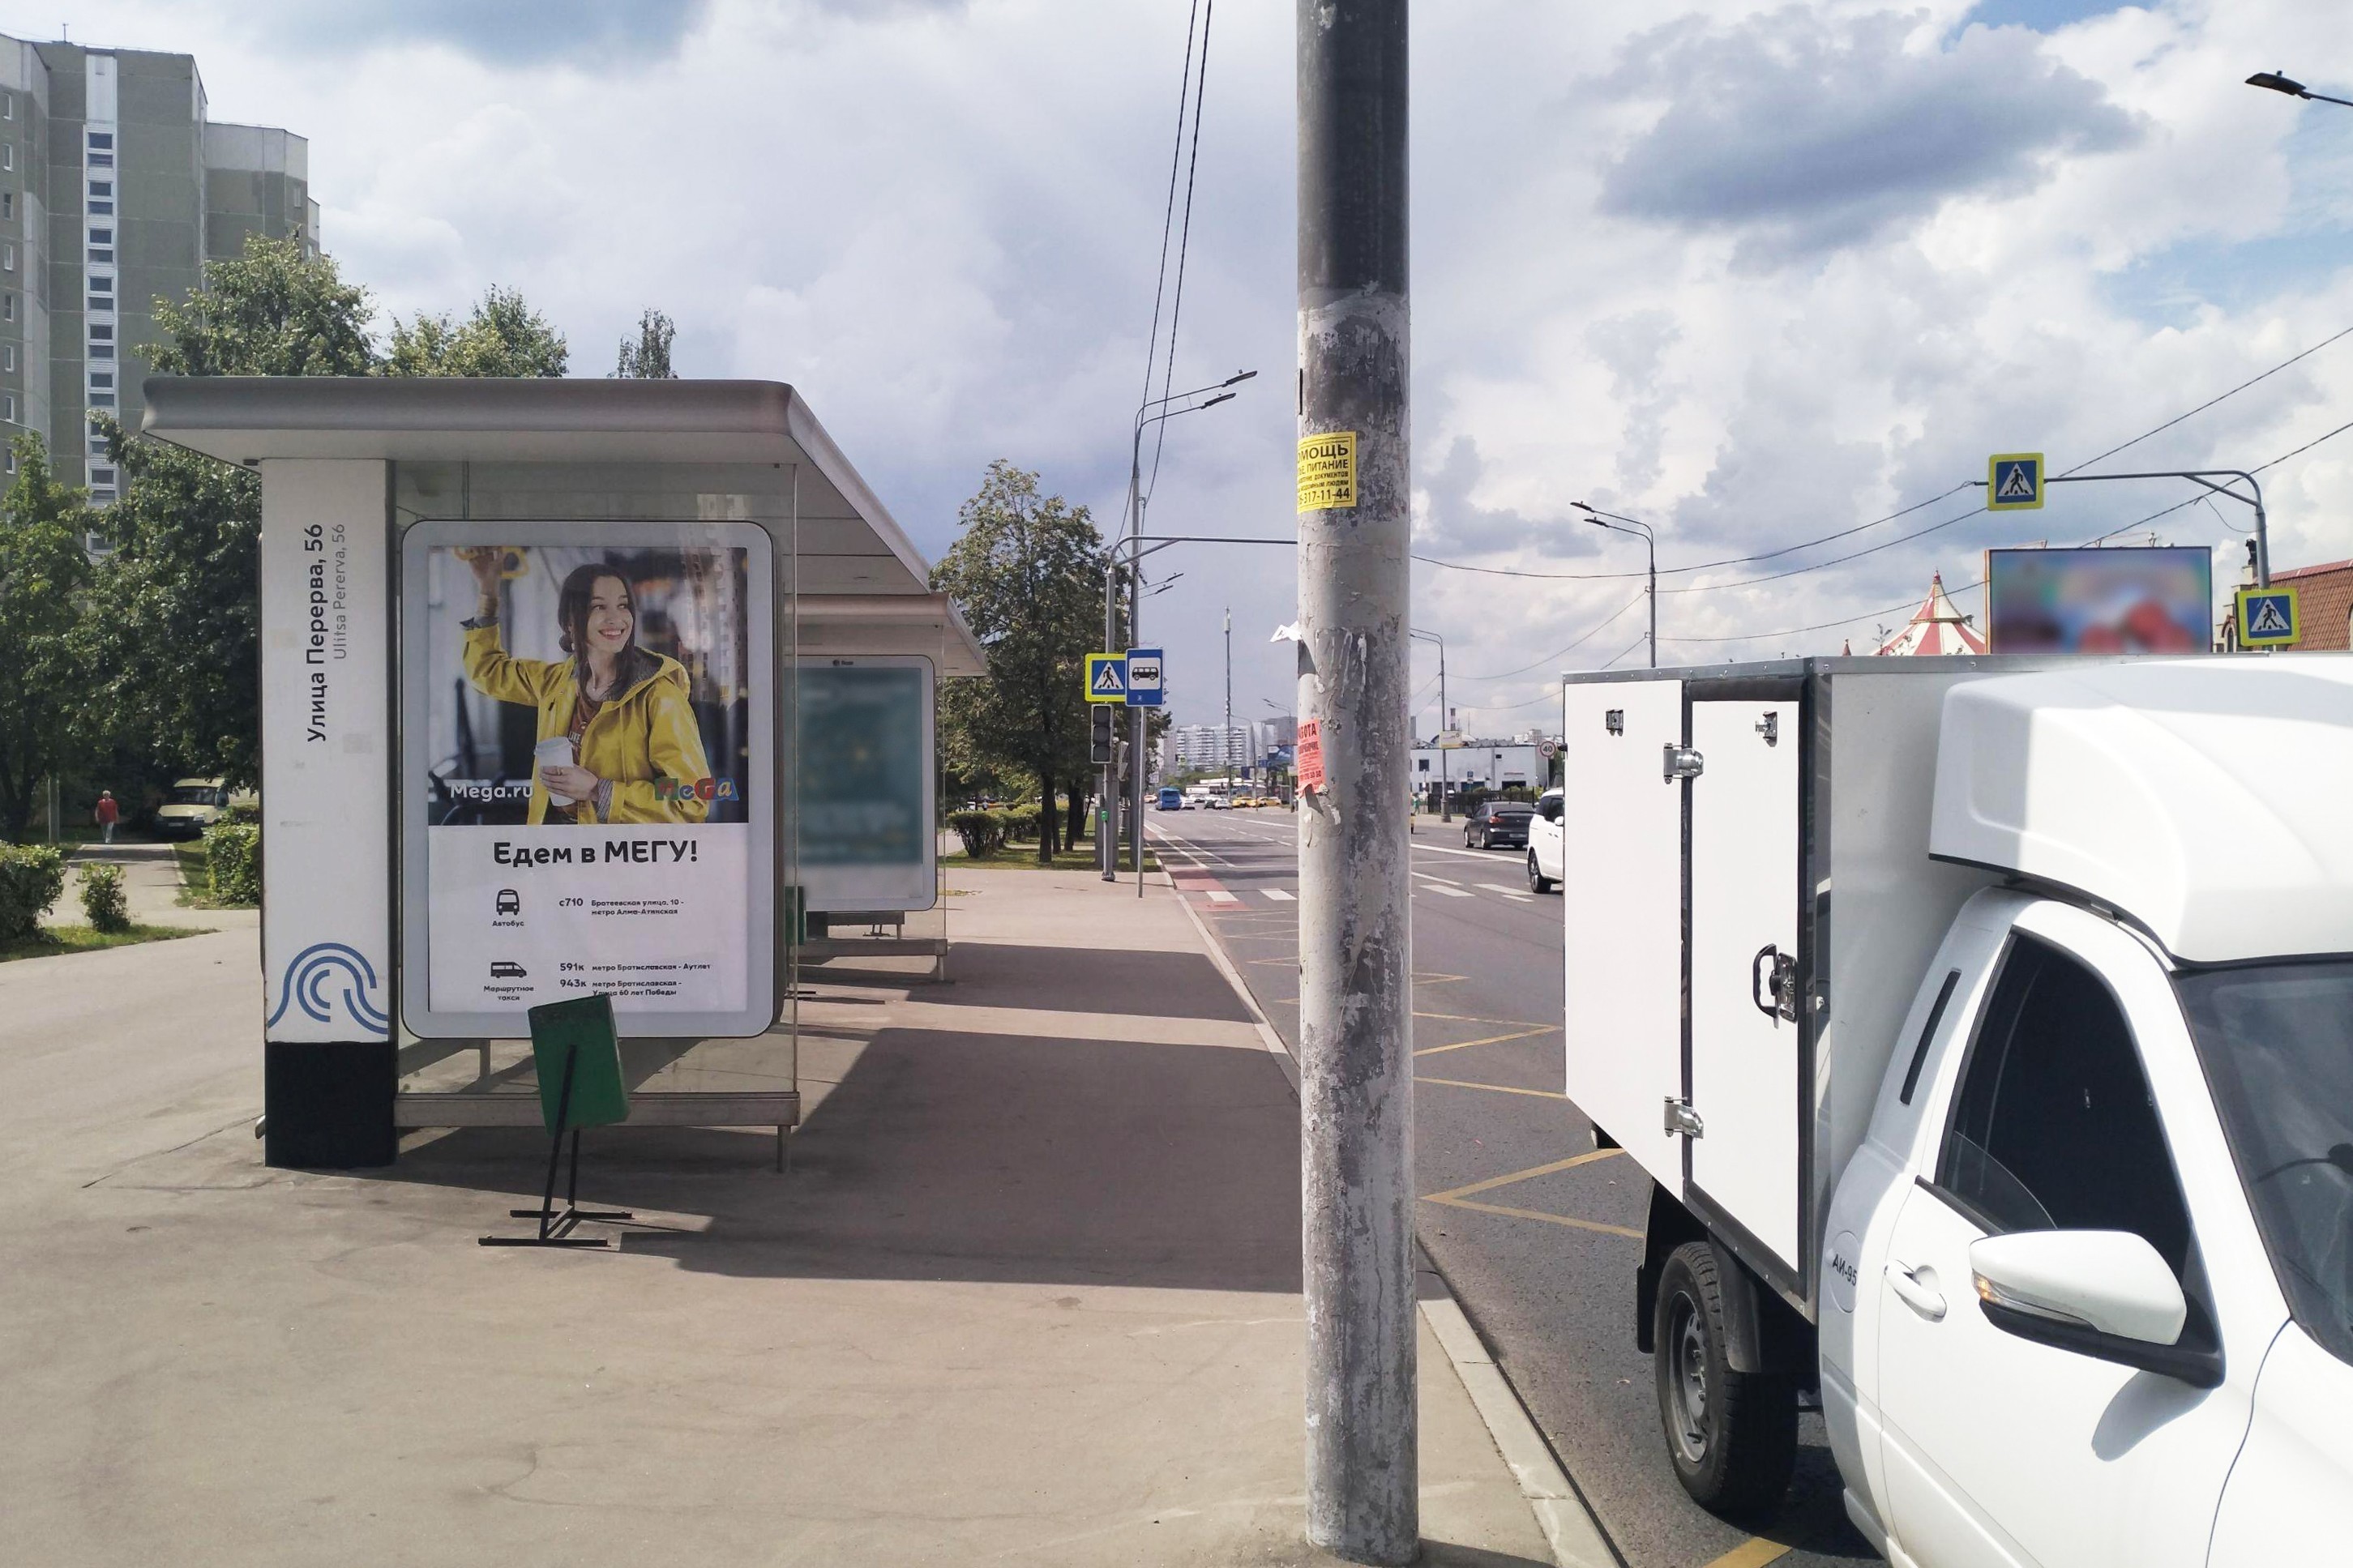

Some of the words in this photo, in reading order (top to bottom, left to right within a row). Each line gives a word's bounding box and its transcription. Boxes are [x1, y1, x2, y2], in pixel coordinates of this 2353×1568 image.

[1307, 459, 1349, 472] ПИТАНИЕ
[304, 523, 323, 551] 56
[332, 523, 345, 543] 56
[332, 547, 348, 609] Pererva,
[306, 559, 329, 664] Перерва,
[333, 614, 347, 660] Ulitsa
[306, 673, 327, 742] Улица
[450, 783, 533, 802] Mega.ru
[493, 842, 572, 868] Едем
[581, 848, 596, 863] в
[604, 840, 698, 863] МЕГУ!
[492, 920, 525, 928] Автобус
[682, 963, 711, 972] Аутлет
[617, 980, 678, 988] Братиславская
[1832, 1254, 1858, 1287] АИ-95
